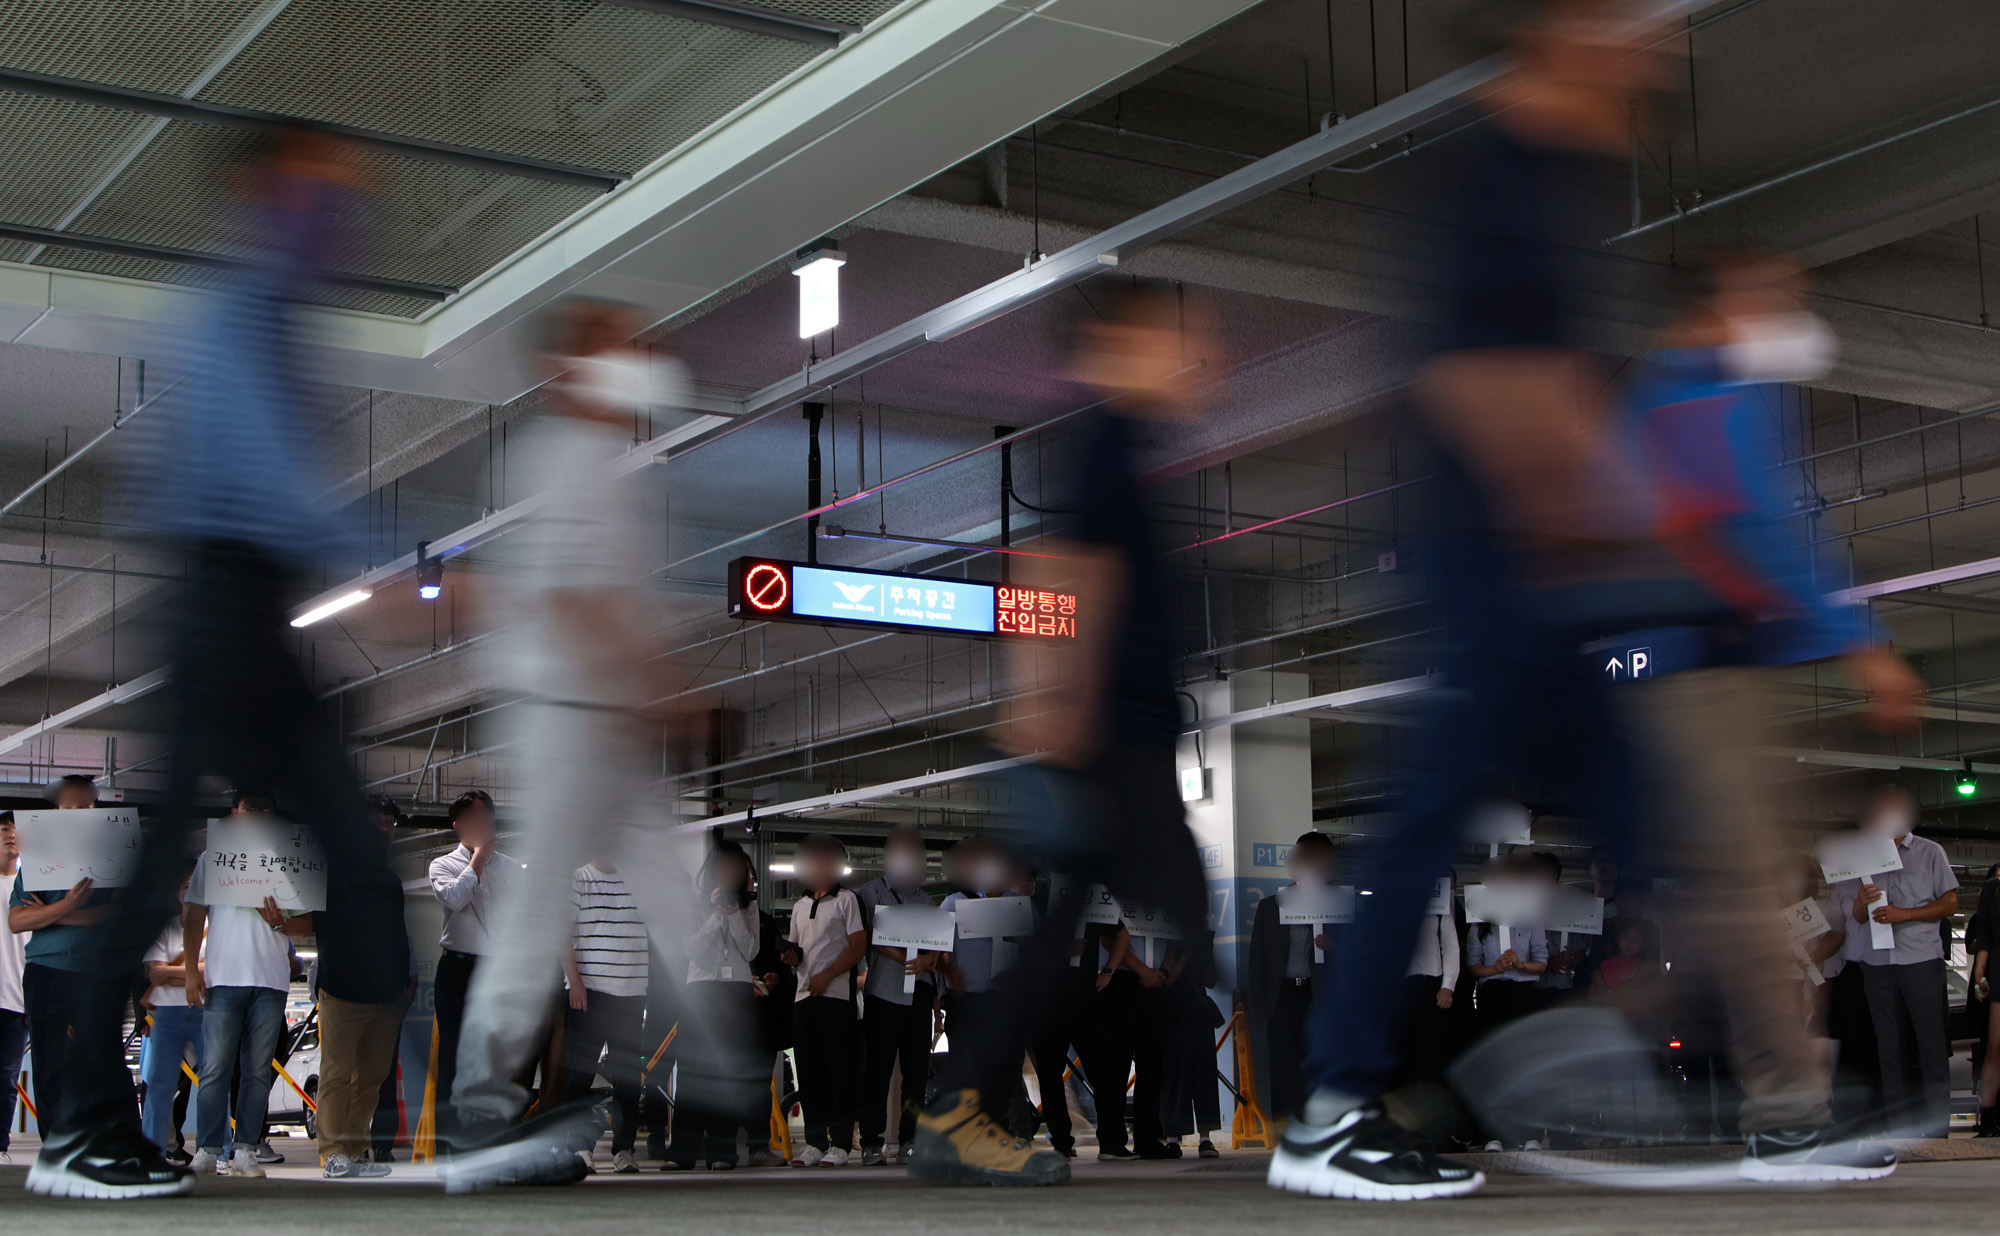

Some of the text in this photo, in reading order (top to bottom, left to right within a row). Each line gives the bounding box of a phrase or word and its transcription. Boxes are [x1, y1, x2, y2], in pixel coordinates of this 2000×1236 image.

[997, 587, 1077, 615] 일방통행
[894, 607, 952, 621] Parking Spaces
[997, 610, 1076, 638] 진입금지
[1632, 652, 1648, 678] P
[213, 851, 325, 874] 귀국을 환영합니다
[1206, 848, 1220, 865] 4F
[1257, 848, 1272, 864] P1
[218, 876, 263, 887] Welcome
